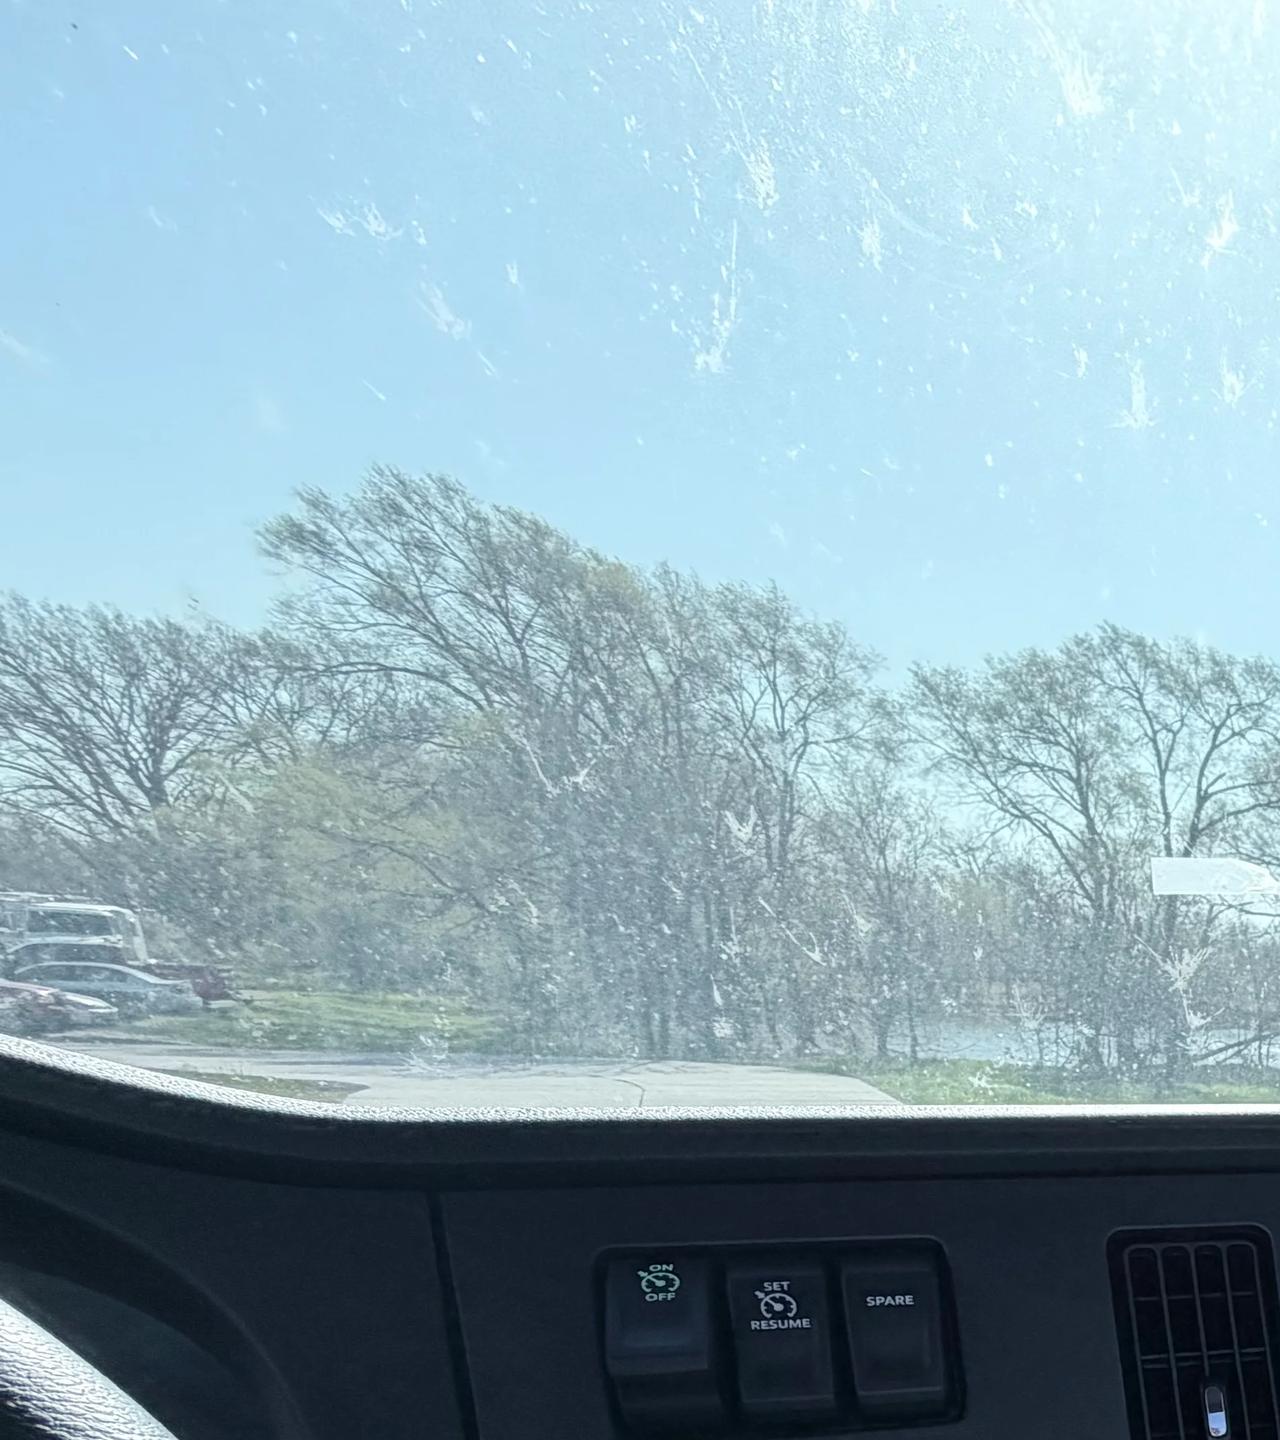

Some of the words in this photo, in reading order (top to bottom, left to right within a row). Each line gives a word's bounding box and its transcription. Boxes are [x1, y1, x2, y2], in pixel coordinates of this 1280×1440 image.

[649, 1263, 674, 1272] ON
[763, 1281, 791, 1292] SET
[645, 1292, 676, 1302] OFF
[866, 1294, 915, 1307] SPARE
[750, 1318, 812, 1331] RESUME
